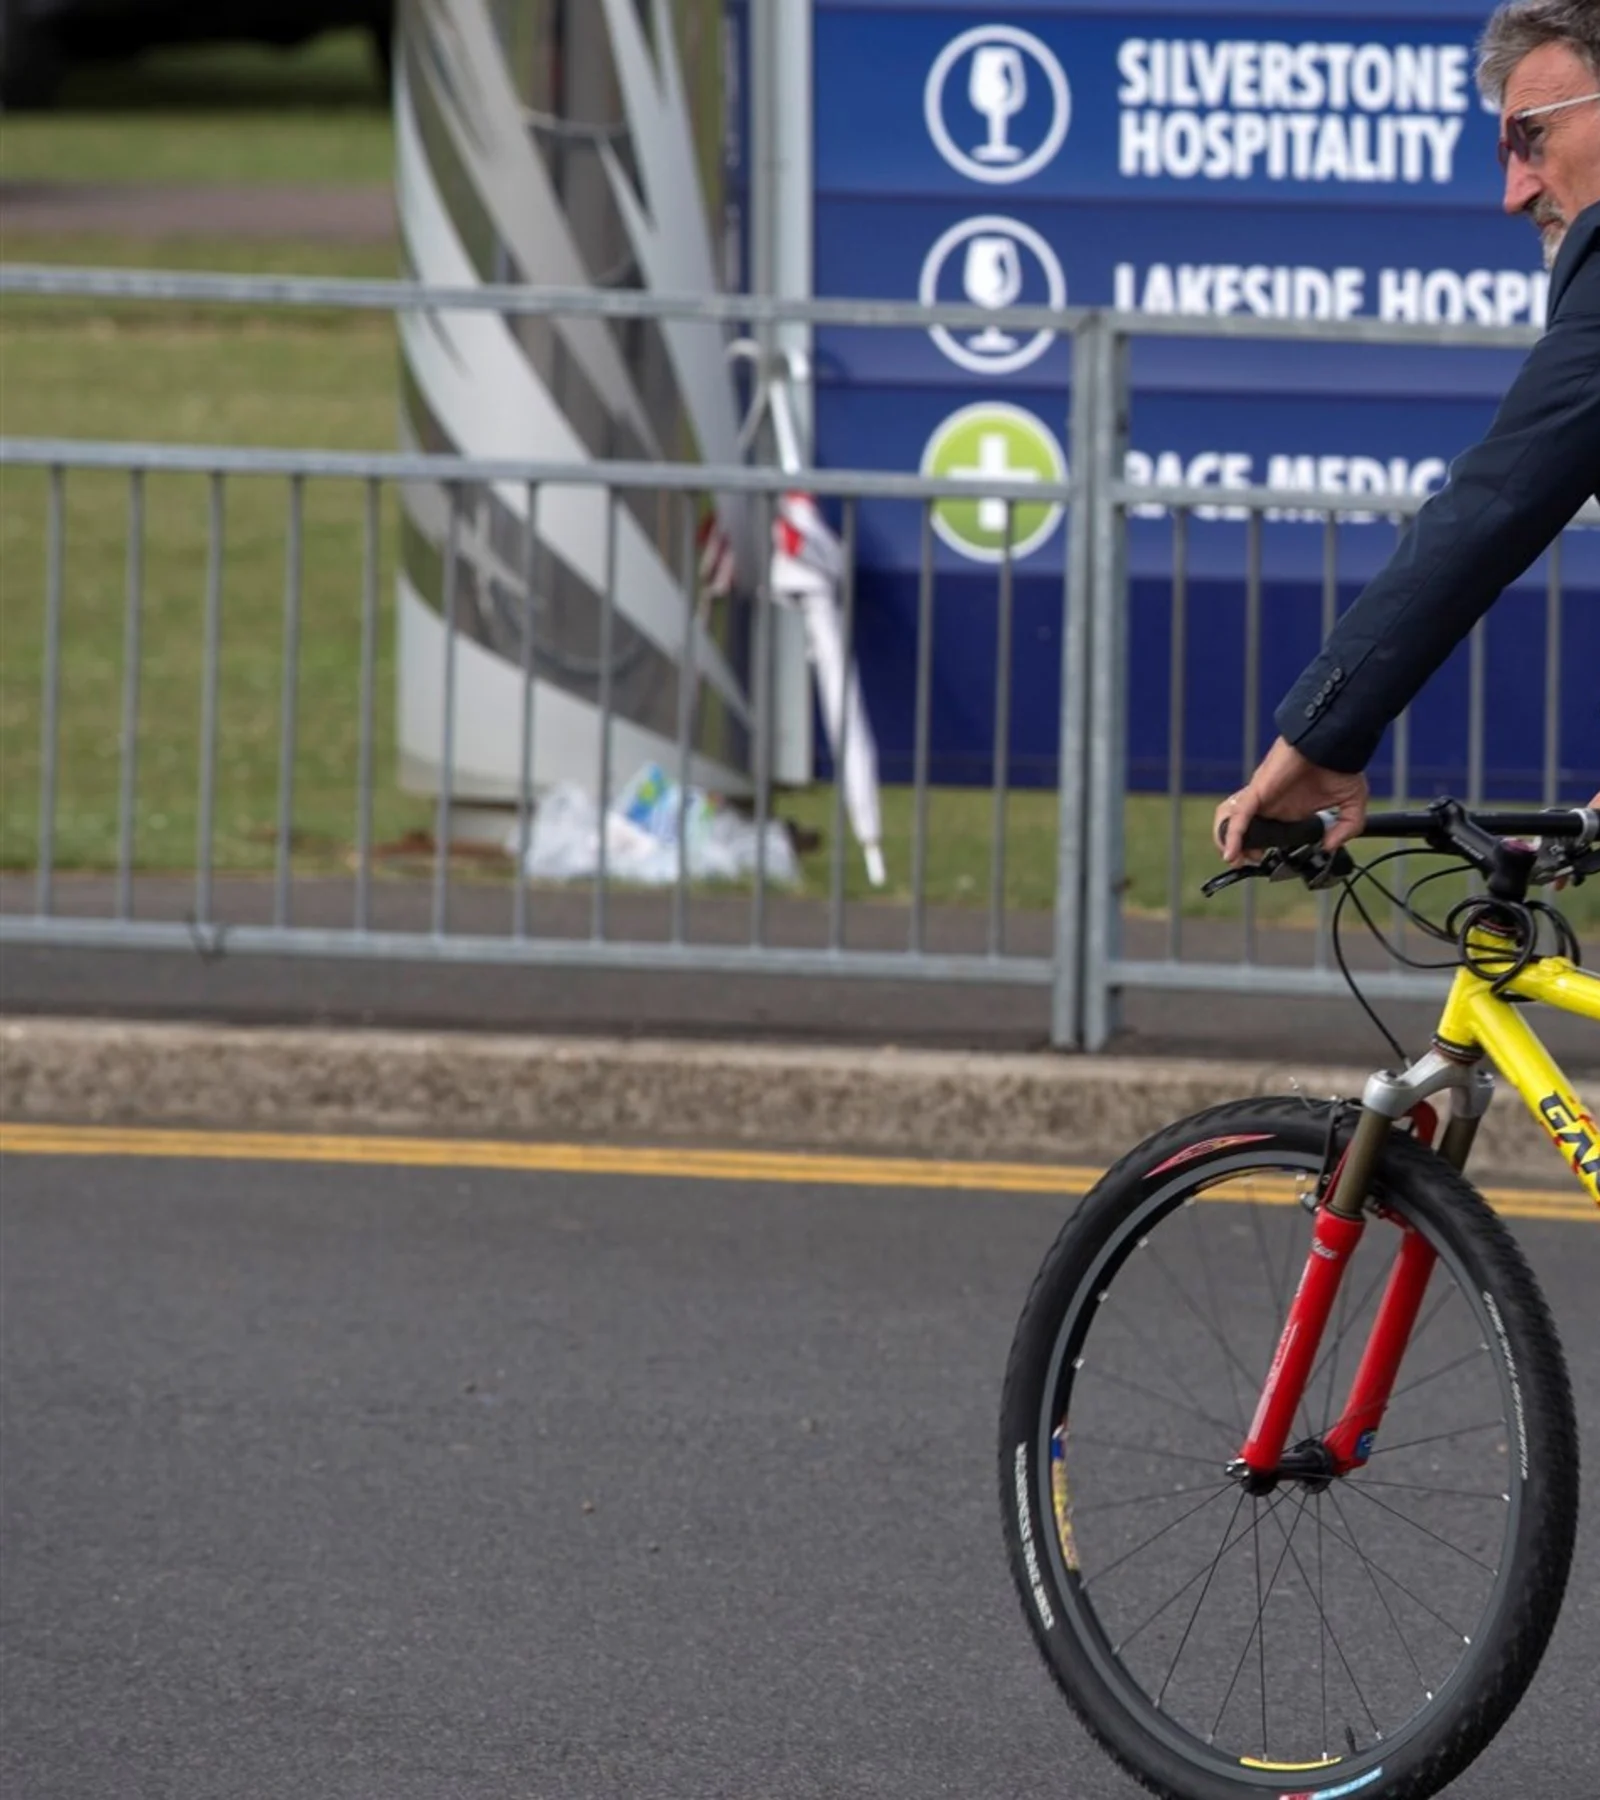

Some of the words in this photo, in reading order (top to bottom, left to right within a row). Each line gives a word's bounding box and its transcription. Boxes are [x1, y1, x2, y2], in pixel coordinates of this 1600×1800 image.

[1117, 37, 1469, 112] SILVERSTONE
[1118, 109, 1464, 183] HOSPITALITY
[1114, 262, 1366, 320] LAKESIDE
[1379, 267, 1548, 328] HOSPI
[1263, 454, 1447, 525] MEDIC
